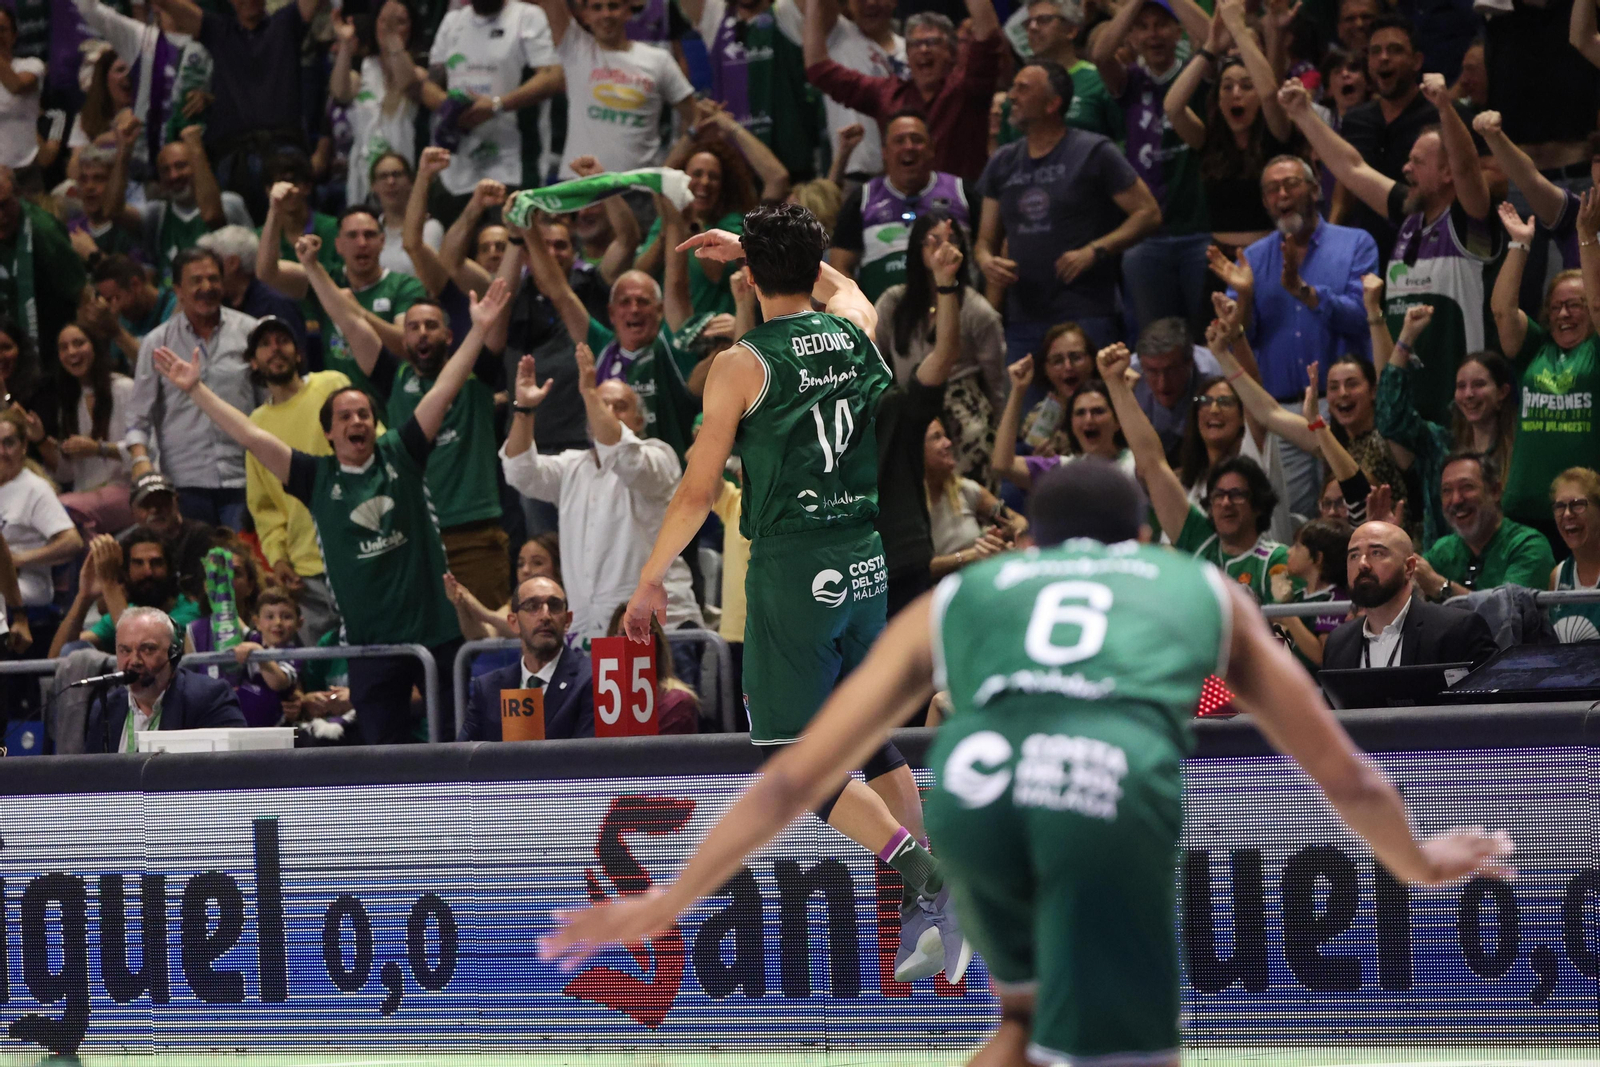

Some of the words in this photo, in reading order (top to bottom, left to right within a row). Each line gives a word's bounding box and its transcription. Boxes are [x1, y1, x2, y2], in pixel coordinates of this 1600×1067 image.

[810, 398, 854, 473] 14
[849, 554, 885, 577] COSTA
[851, 575, 873, 590] DEL
[1024, 579, 1114, 667] 6
[503, 697, 535, 718] IRS
[0, 816, 288, 1055] guel
[562, 794, 863, 1029] San
